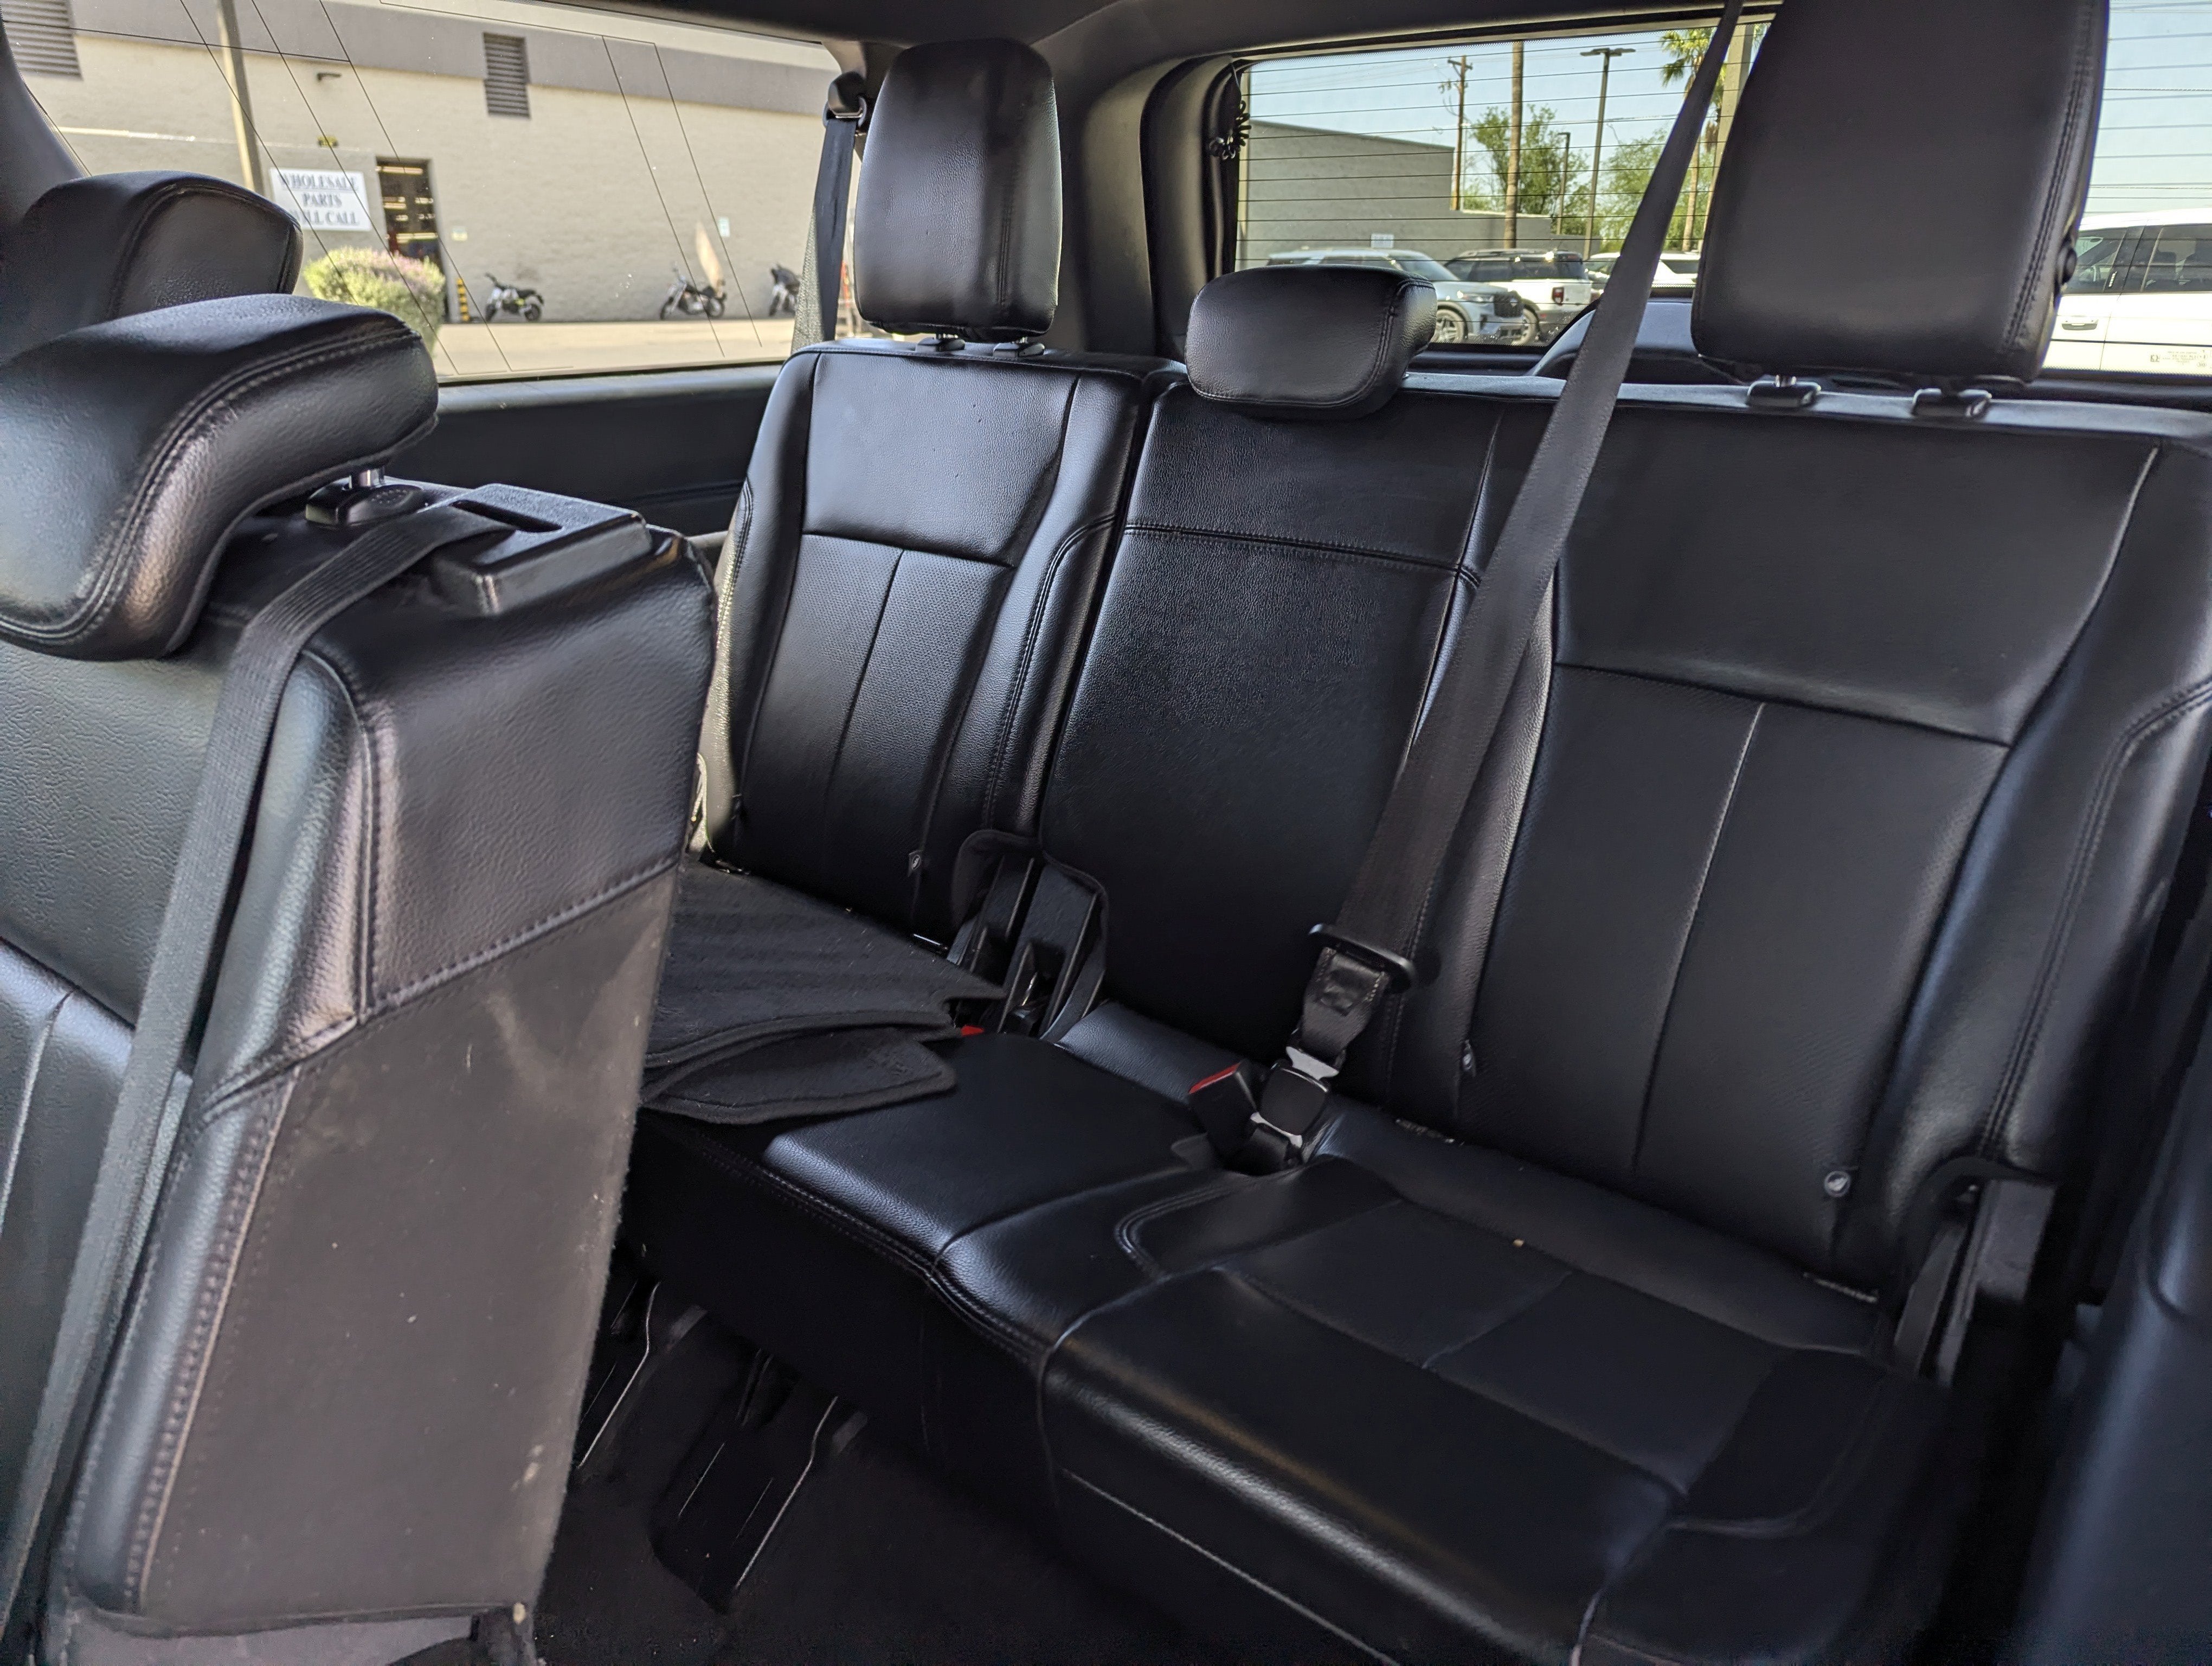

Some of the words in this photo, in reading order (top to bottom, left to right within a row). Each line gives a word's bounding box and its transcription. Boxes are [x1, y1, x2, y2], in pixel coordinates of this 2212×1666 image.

[278, 172, 358, 190] WHOLESALE
[302, 193, 343, 208] PARTS
[326, 210, 359, 226] CALL
